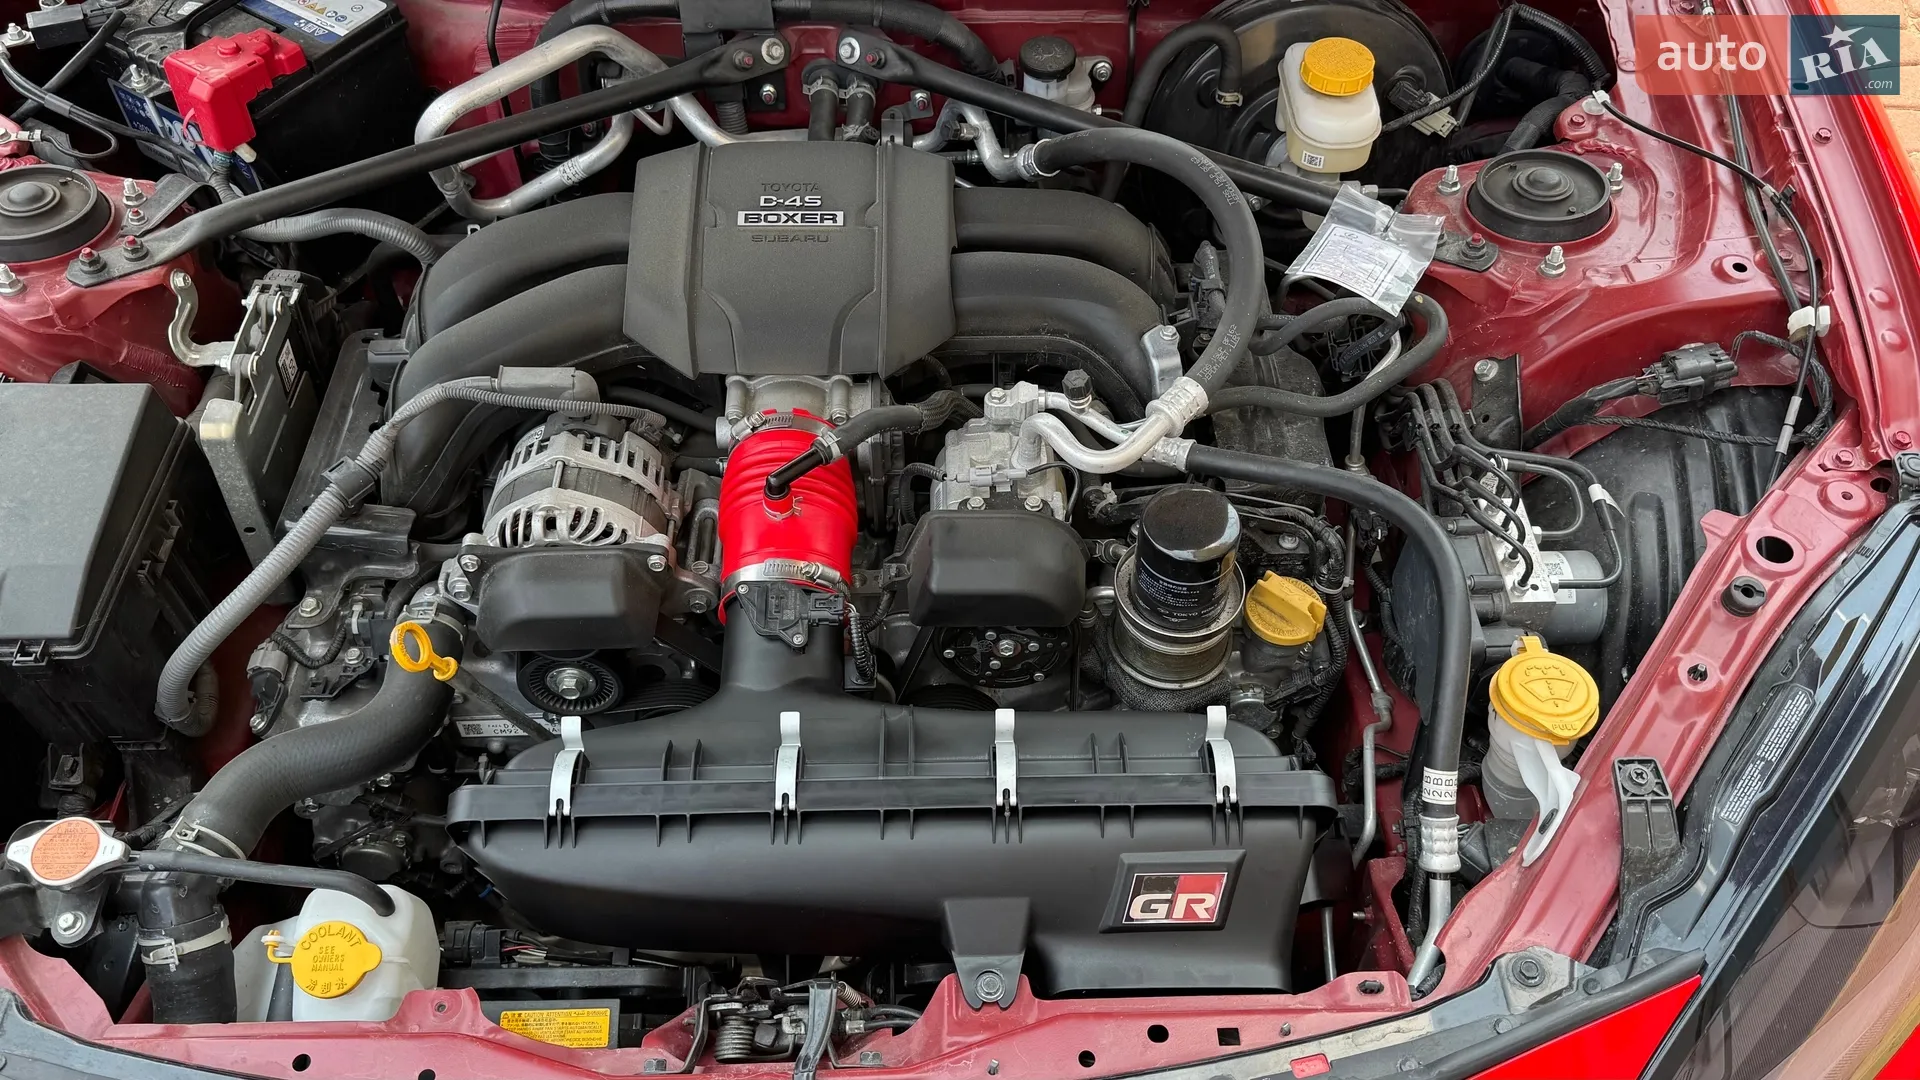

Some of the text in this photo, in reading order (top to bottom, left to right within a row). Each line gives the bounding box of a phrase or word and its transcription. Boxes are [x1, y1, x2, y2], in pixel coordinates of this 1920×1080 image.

[761, 182, 821, 192] TOYOTA
[760, 195, 822, 207] D-4S
[744, 213, 838, 224] BOXER
[751, 234, 830, 243] SUBARU
[1552, 723, 1578, 731] PULL
[1129, 893, 1216, 920] GR
[301, 925, 362, 950] COOLANT
[319, 946, 336, 954] SEE
[312, 954, 345, 964] OWNERS
[312, 963, 344, 972] MANUAL
